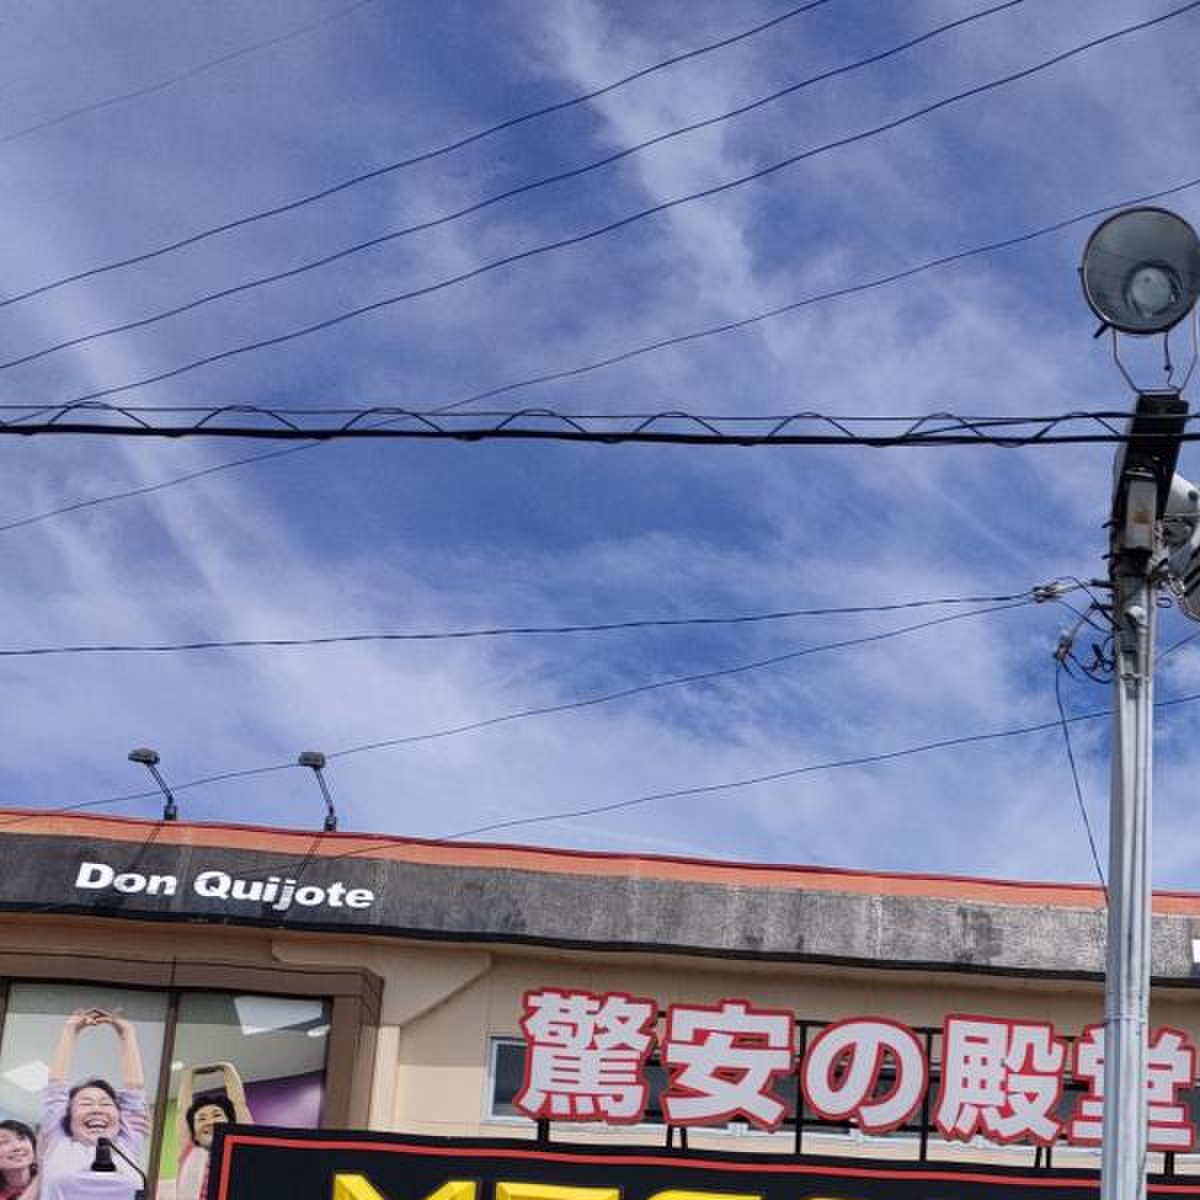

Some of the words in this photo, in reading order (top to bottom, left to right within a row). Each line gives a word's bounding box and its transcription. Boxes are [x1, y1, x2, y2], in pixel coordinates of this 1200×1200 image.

[75, 861, 177, 897] Don
[193, 871, 375, 911] Quijote
[516, 988, 1195, 1151] 驚安の殿堂
